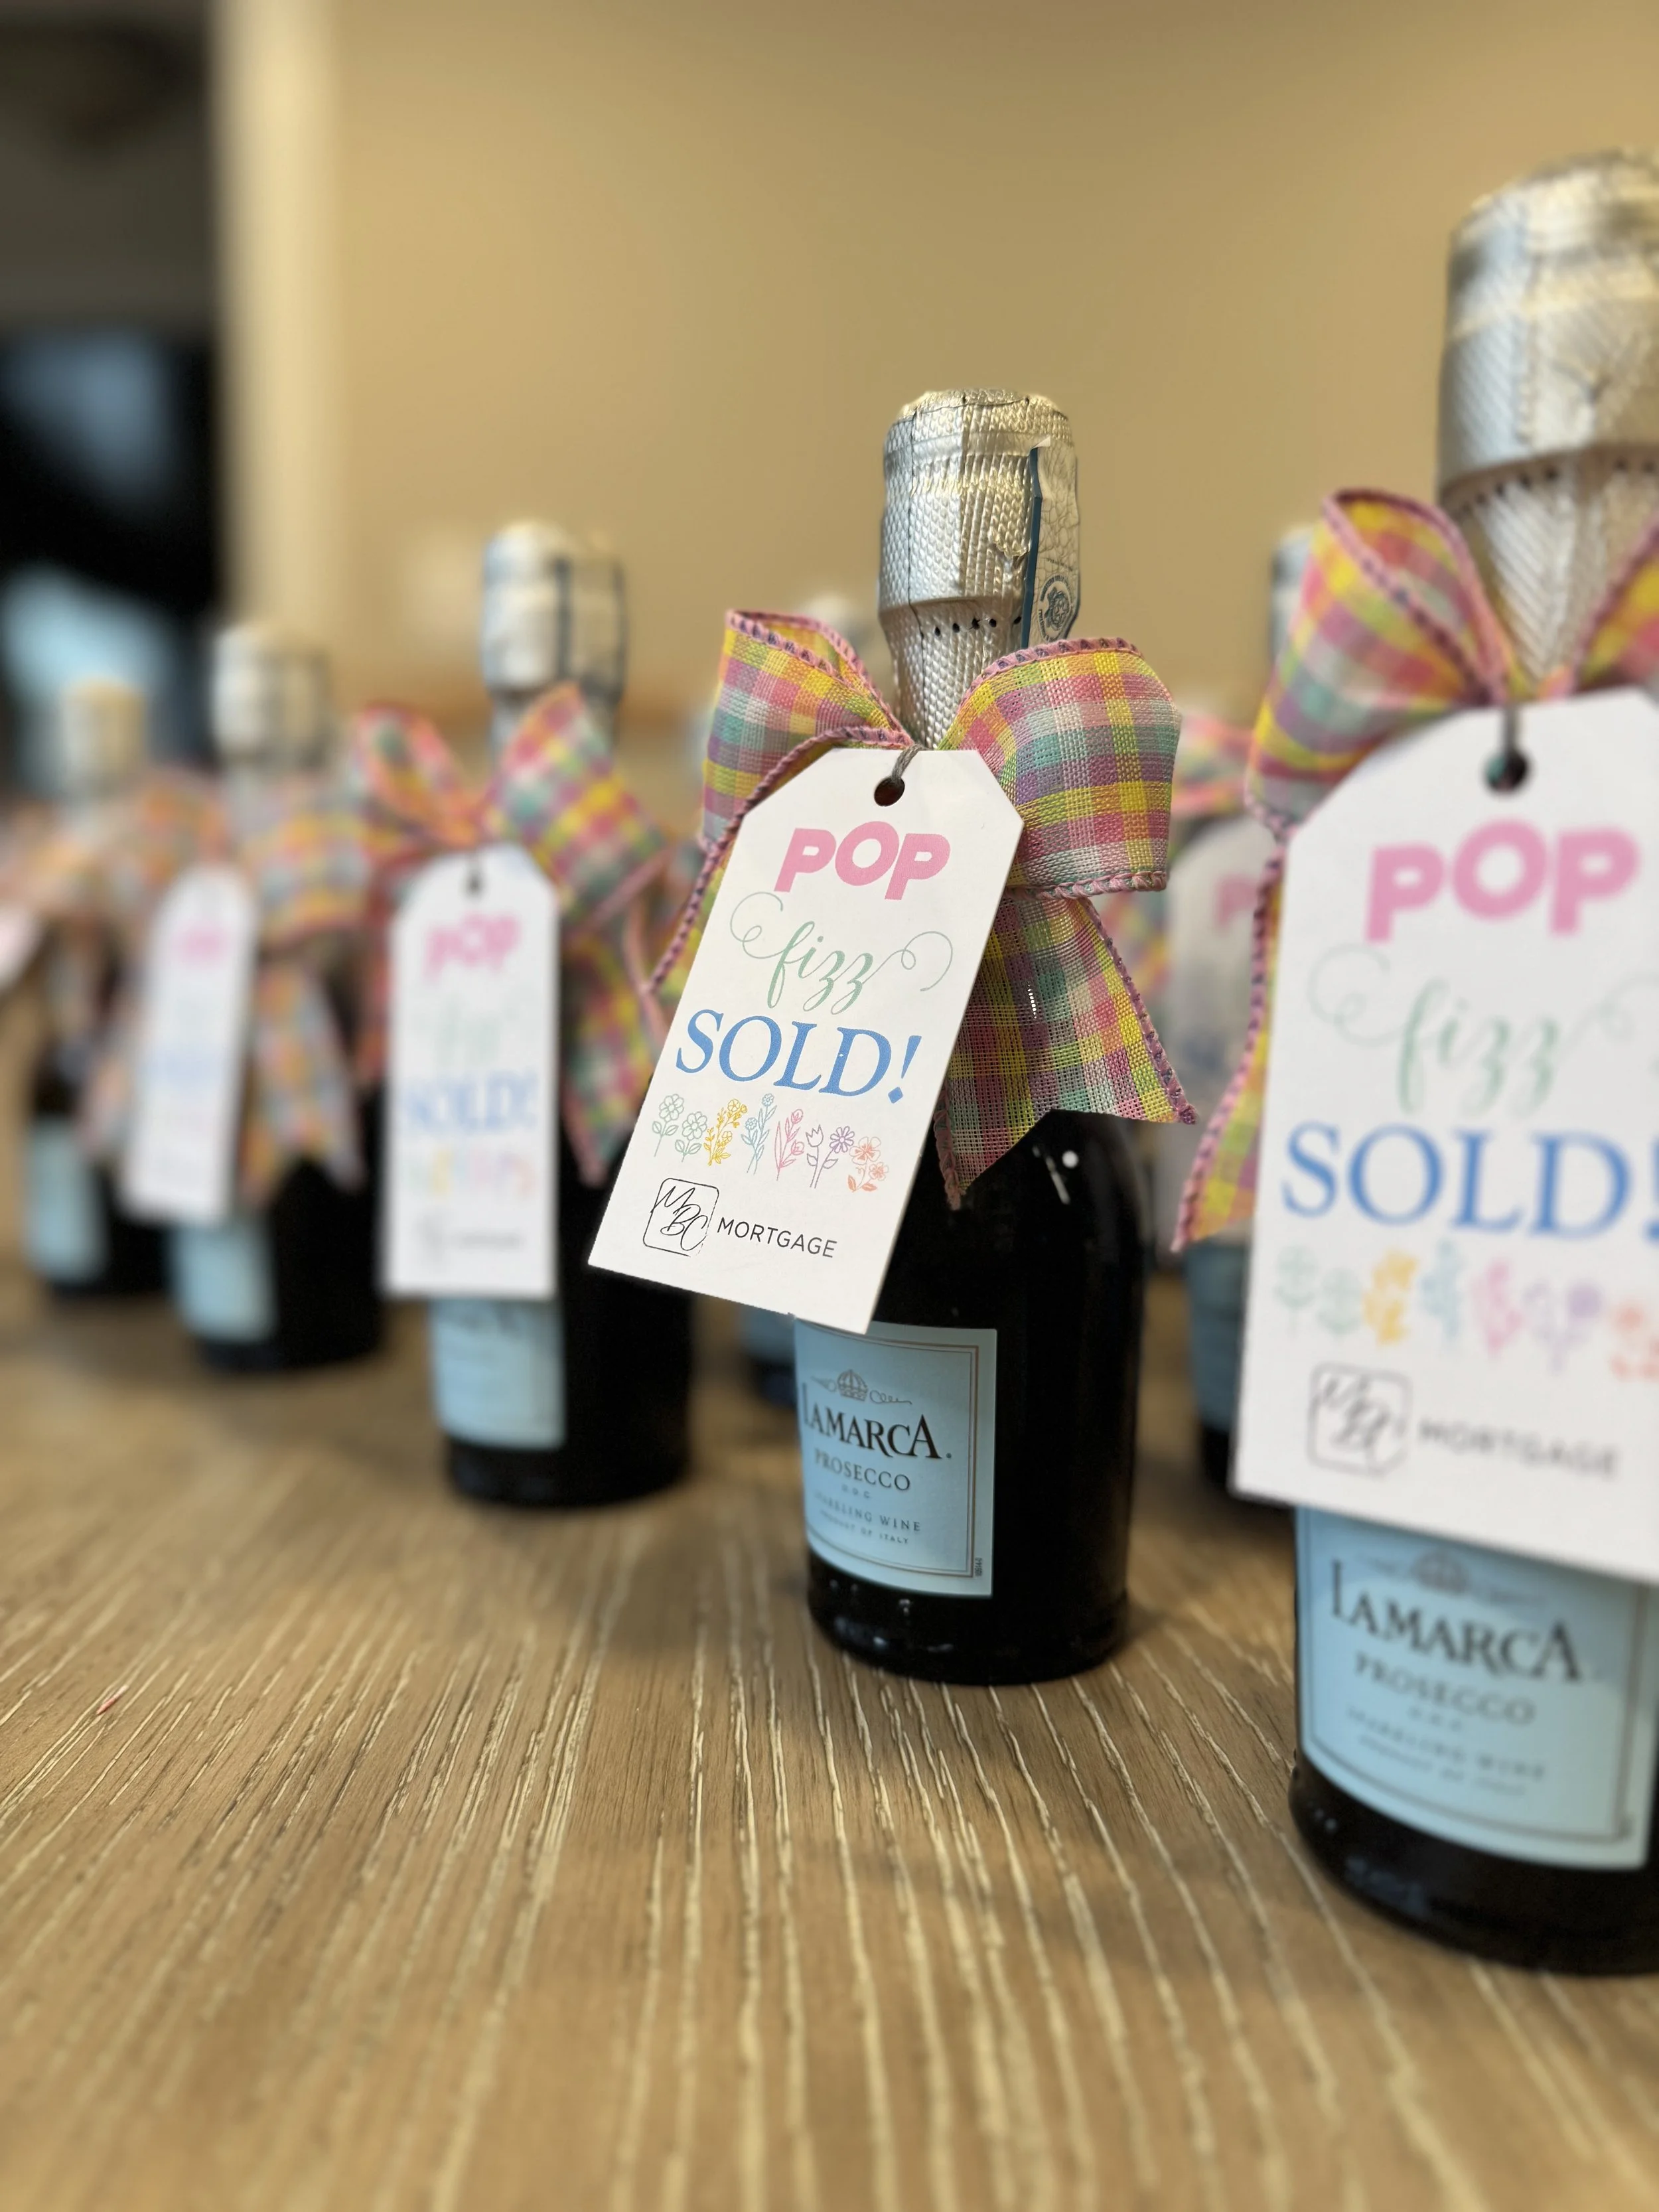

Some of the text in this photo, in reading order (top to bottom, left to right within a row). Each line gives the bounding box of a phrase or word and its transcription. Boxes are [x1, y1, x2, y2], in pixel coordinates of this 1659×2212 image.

[774, 820, 951, 901] POP
[1365, 818, 1640, 942] POP
[425, 913, 520, 981] POP
[730, 891, 954, 1015] fizz
[676, 1009, 922, 1104] SOLD!
[650, 1185, 837, 1258] MBC MORTGAGE
[814, 1447, 910, 1491] PROSECCO
[879, 1514, 920, 1531] WINE
[879, 1533, 908, 1544] ITALY
[1354, 1651, 1536, 1727] PROSECCO
